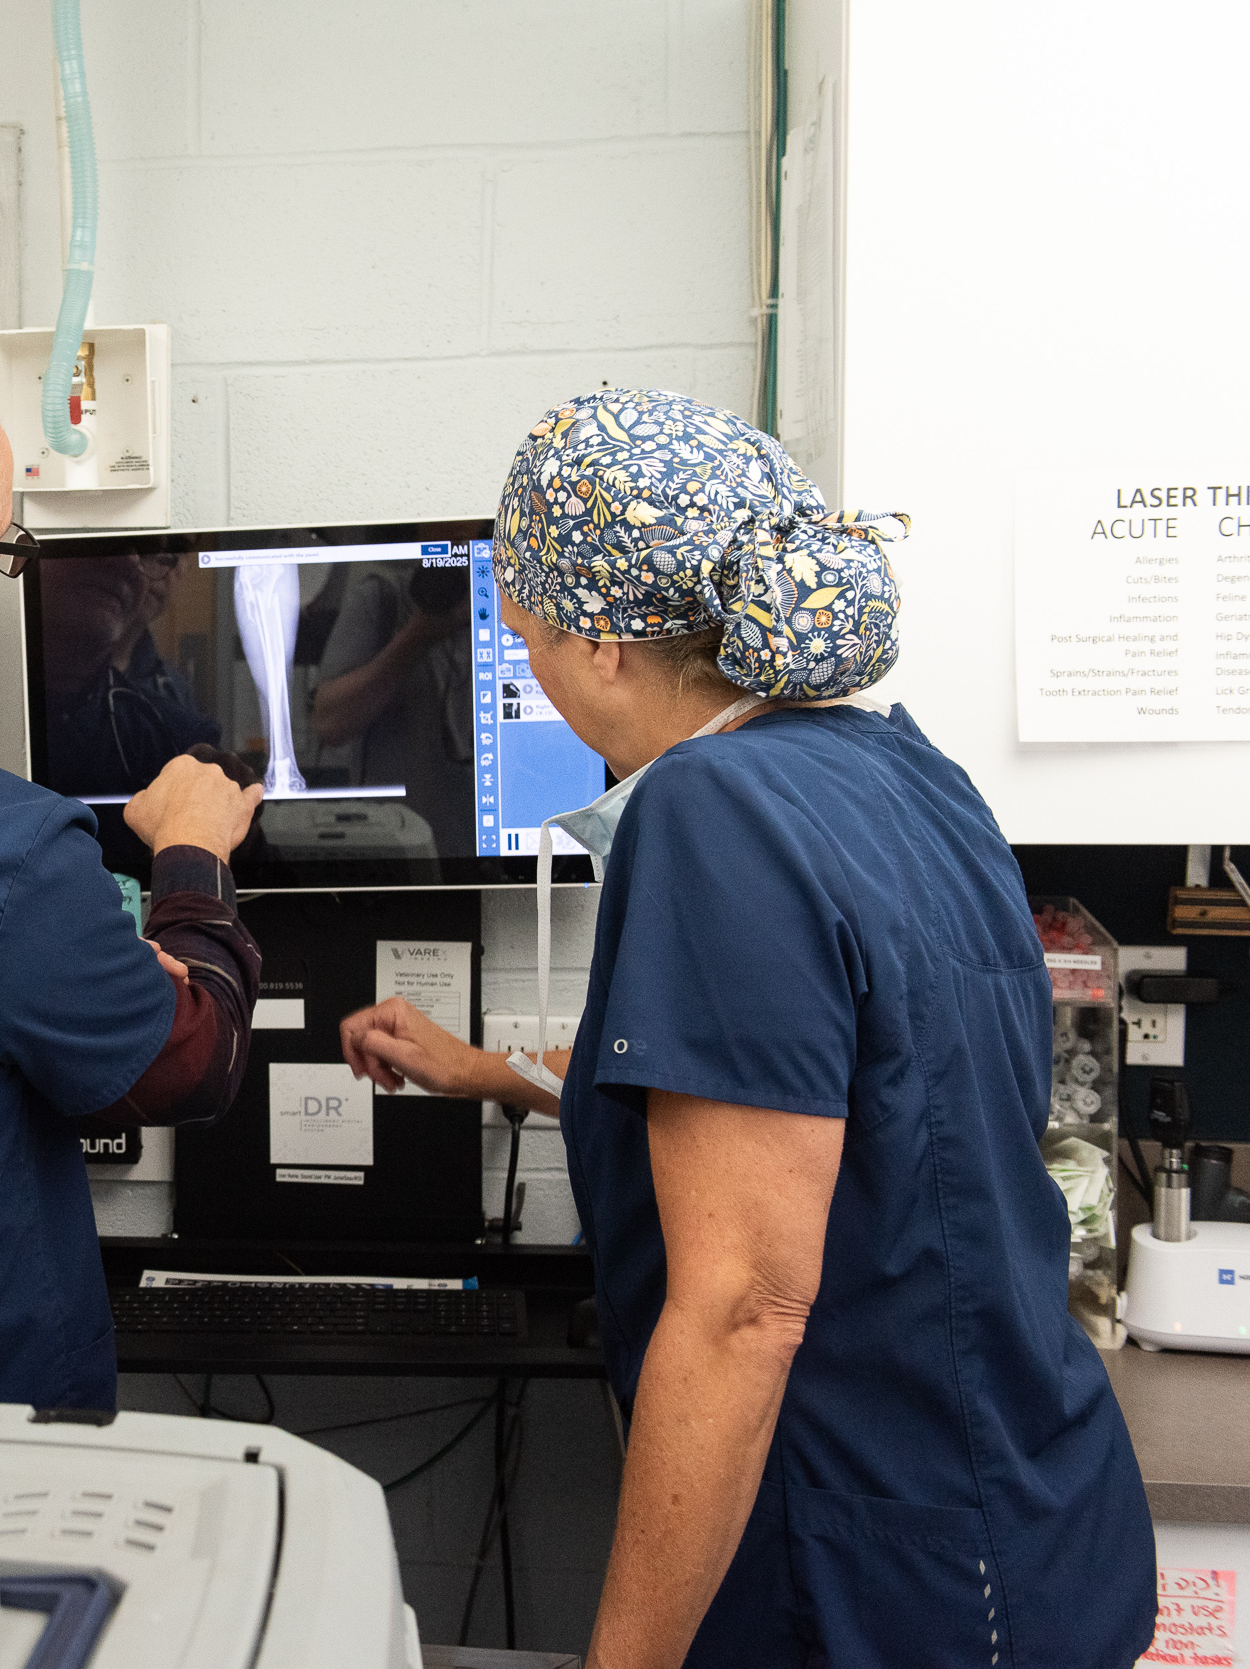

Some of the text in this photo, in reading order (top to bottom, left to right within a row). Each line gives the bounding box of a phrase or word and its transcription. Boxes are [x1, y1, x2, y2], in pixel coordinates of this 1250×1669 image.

[1116, 486, 1198, 509] LASER
[1090, 517, 1178, 540] ACUTE
[452, 545, 468, 555] AM
[422, 556, 469, 568] 8/19/2025
[1135, 556, 1180, 566] Allergies
[1126, 574, 1179, 585] Cuts/Bites
[1216, 573, 1250, 584] Degen
[1128, 594, 1179, 604] Infections
[1216, 592, 1247, 602] Feline
[1110, 613, 1179, 624] Inflammation
[1051, 632, 1179, 645] Post Surgical Healing and
[1216, 632, 1233, 643] Hip
[1124, 648, 1179, 658] Pain Relief
[478, 672, 492, 681] ROI
[1050, 667, 1179, 679] Sprains/Strains/Fractures
[1039, 686, 1179, 697] Tooth Extraction Pain Relief
[1216, 686, 1235, 696] Lick
[1136, 705, 1180, 716] Wounds
[1216, 705, 1250, 715] Tendo
